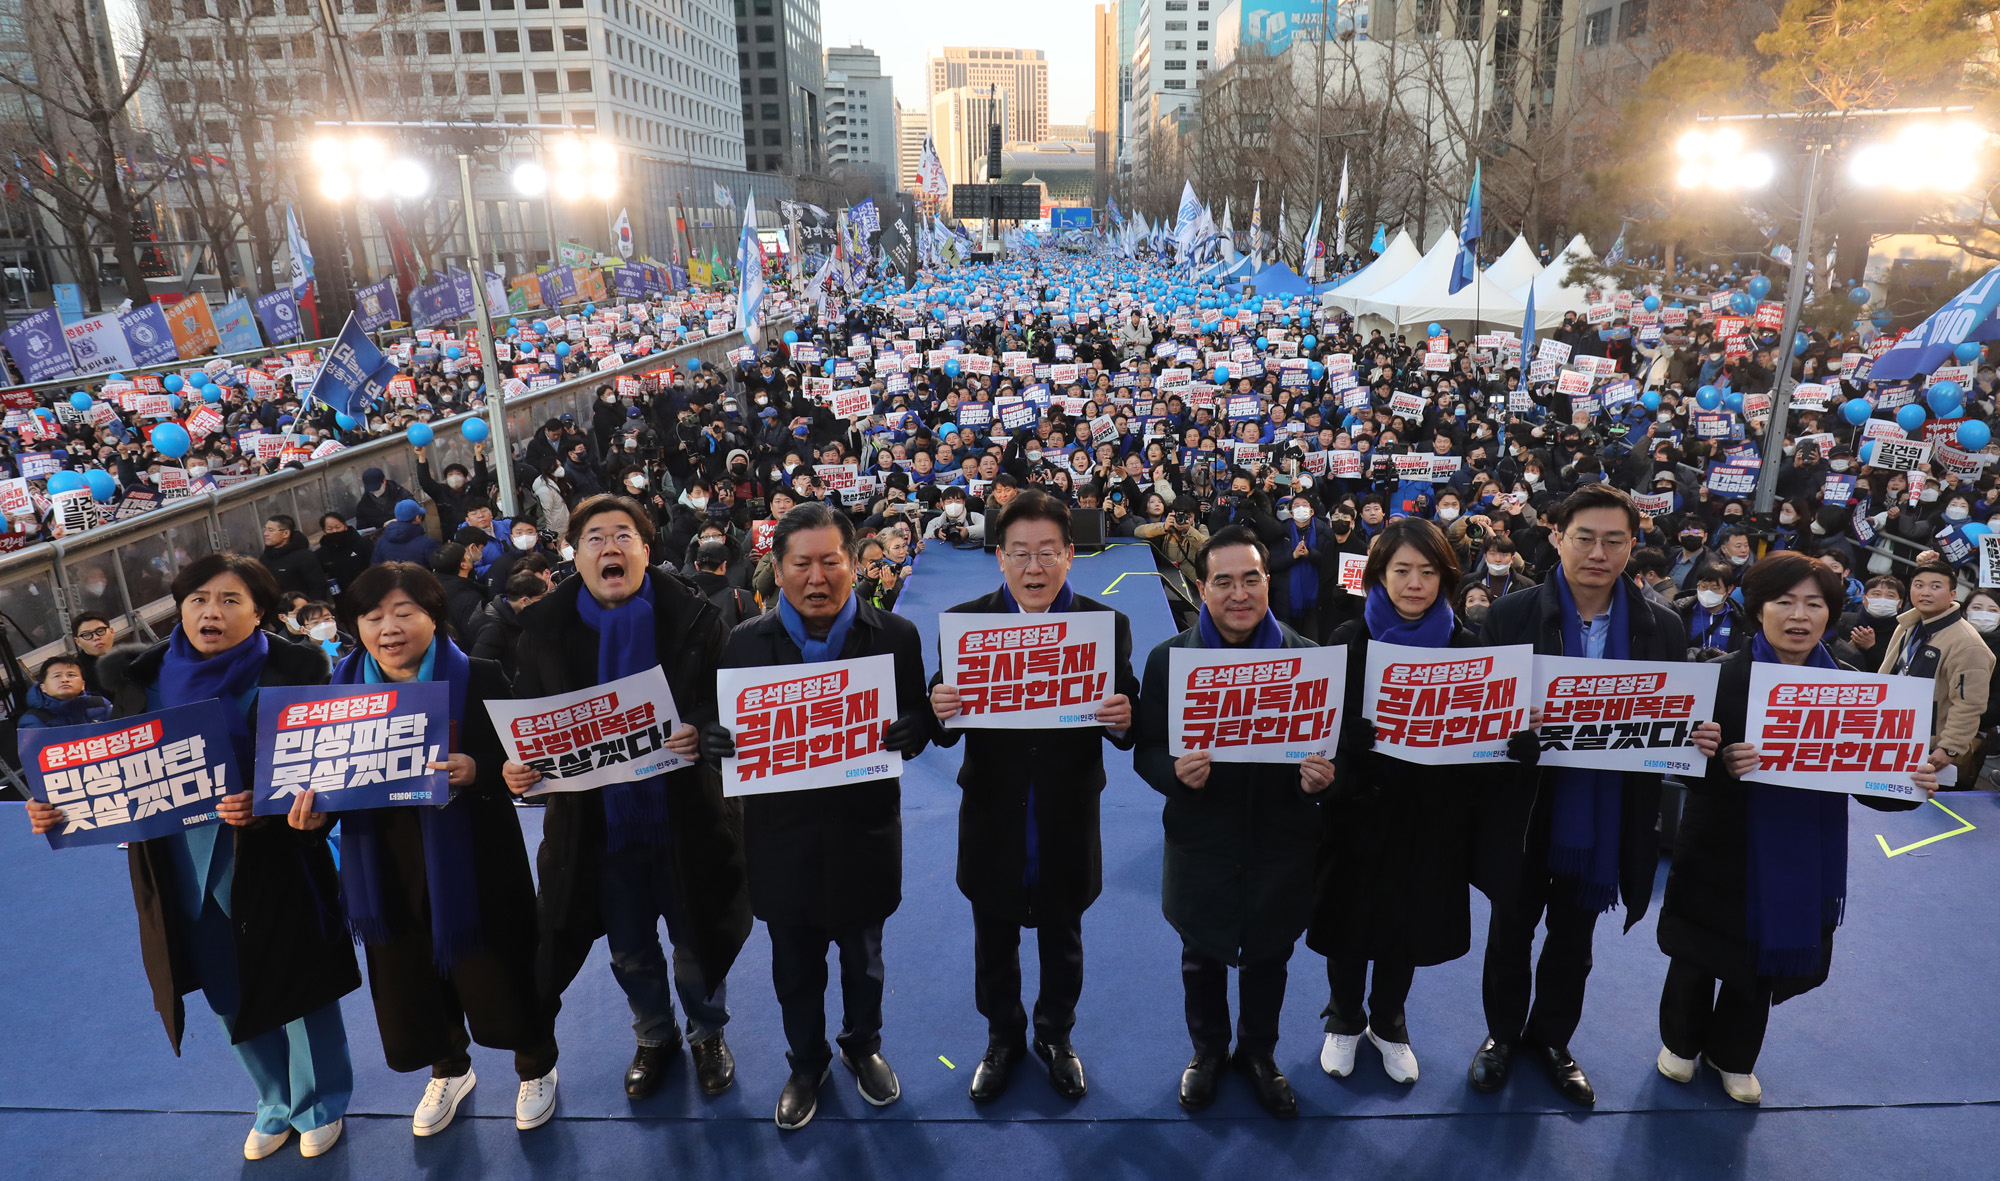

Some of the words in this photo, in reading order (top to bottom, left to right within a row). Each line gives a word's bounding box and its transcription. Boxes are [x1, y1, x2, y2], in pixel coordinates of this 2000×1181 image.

[1559, 384, 1588, 393] 규탄한다!
[1561, 378, 1589, 387] 검사독재
[1877, 455, 1919, 471] 특검!
[1881, 442, 1923, 459] 김건희
[1708, 480, 1756, 493] 해결하라!
[1709, 473, 1755, 485] 물가폭탄
[965, 626, 1060, 652] 윤석열정권
[957, 642, 1097, 685] 검사독재
[1195, 661, 1294, 687] 윤석열정권
[1390, 659, 1489, 684] 윤석열정권
[744, 674, 841, 710] 윤석열정권
[957, 672, 1107, 716] 규탄한다!
[1183, 677, 1330, 720] 검사독재
[1376, 676, 1518, 718] 검사독재
[1555, 674, 1659, 698] 윤석열정권
[1775, 685, 1879, 706] 윤석열정권
[286, 694, 388, 727] 윤석열정권
[516, 697, 611, 737] 윤석열정권
[735, 688, 880, 749] 검사독재
[1544, 694, 1696, 723] 난방비폭탄
[272, 713, 428, 765] 민생파탄
[515, 702, 656, 761] 난방비폭탄
[1181, 707, 1337, 750] 규탄한다!
[1374, 707, 1523, 748] 규탄한다!
[1539, 720, 1705, 751] 못살겠다!
[1762, 708, 1917, 741] 검사독재
[43, 723, 156, 769] 윤석열정권
[520, 720, 671, 781] 못살겠다!
[736, 719, 891, 782] 규탄한다!
[1285, 749, 1327, 760] 더불어민주당
[1472, 749, 1509, 760] 더불어민주
[1758, 742, 1924, 773] 규탄한다!
[42, 734, 207, 799] 민생파탄
[269, 745, 440, 800] 못살겠다!
[635, 757, 679, 776] 더불어민주당
[846, 764, 889, 778] 더불어민주당
[1643, 759, 1691, 771] 더불어민주당
[62, 763, 227, 836] 못살겠다!
[389, 789, 433, 801] 더불어민주당
[1864, 781, 1914, 795] 더불어민주당
